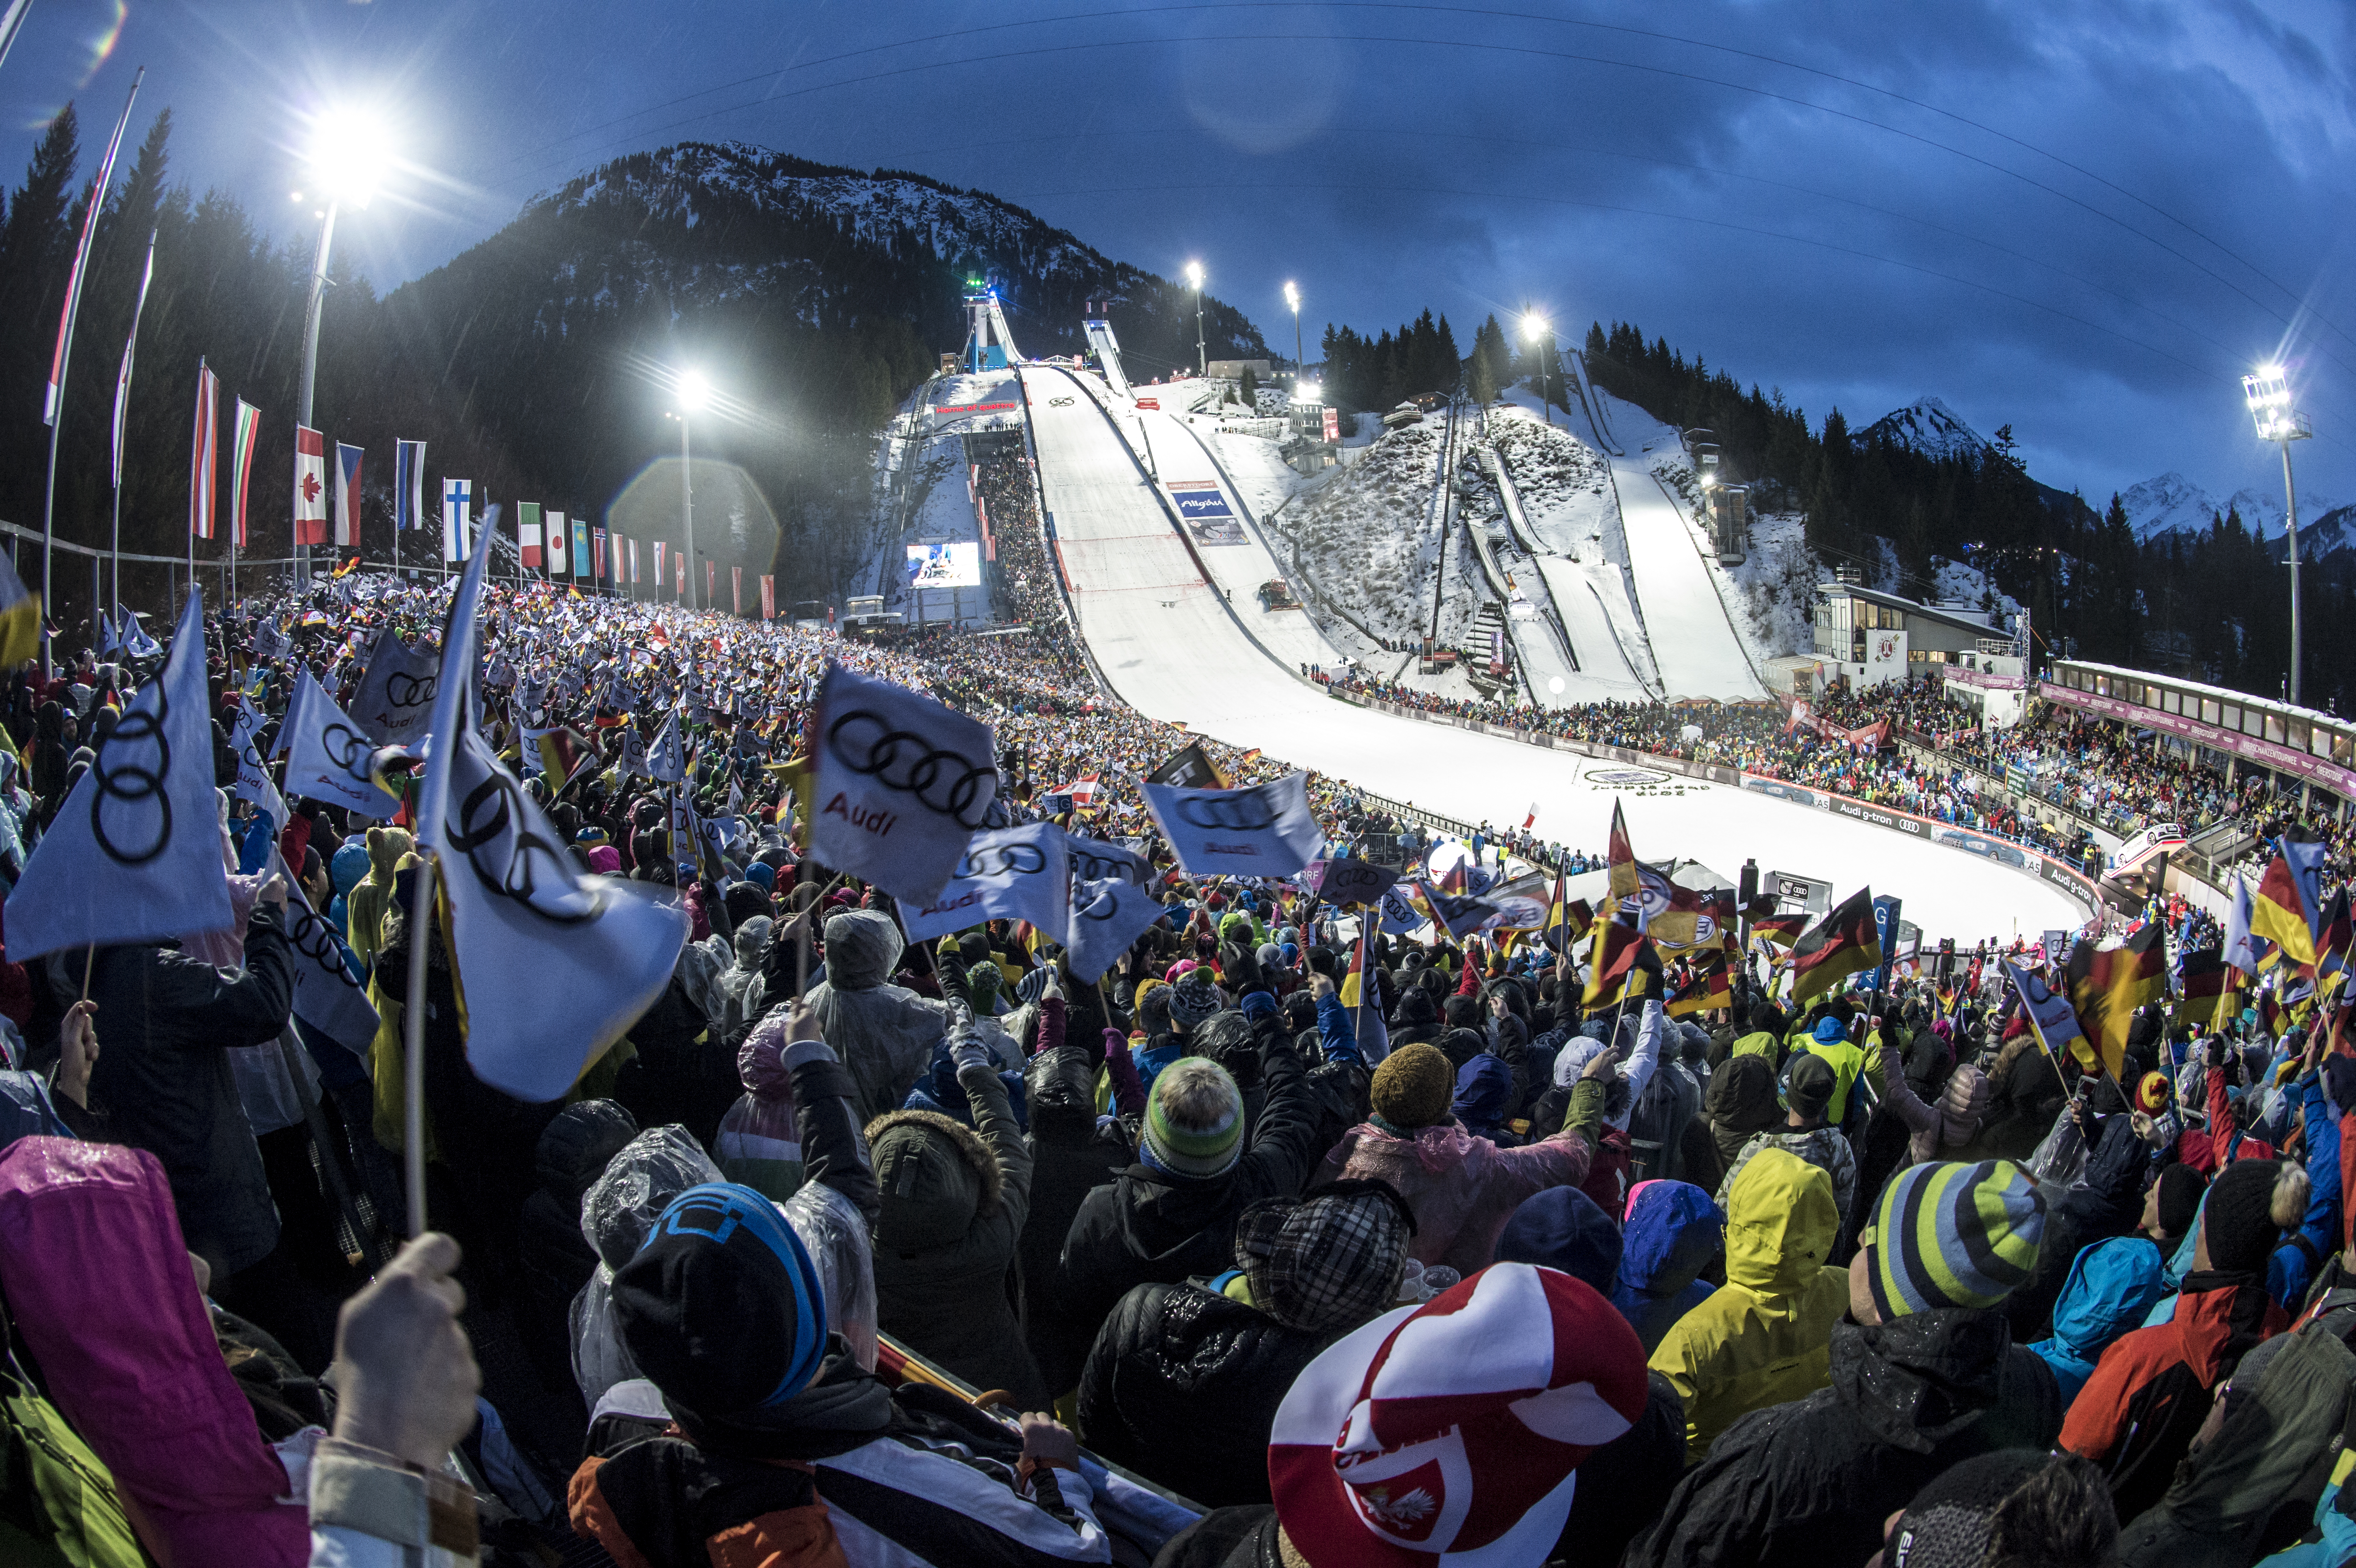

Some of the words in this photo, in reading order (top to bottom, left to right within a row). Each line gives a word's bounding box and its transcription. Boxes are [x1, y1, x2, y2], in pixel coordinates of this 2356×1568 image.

[980, 403, 1015, 411] quattro
[1180, 499, 1224, 510] Allgäu
[374, 712, 416, 729] Audi
[1863, 733, 1877, 743] VIER
[2091, 698, 2112, 710] OBERSTDORF
[2132, 710, 2175, 727] VIERSCHANZENTOURNEE
[2191, 726, 2218, 740] OBERSTDORF
[2243, 740, 2297, 765] VIERSCHANZENTOURNEE
[2316, 765, 2344, 783] OBERSTDORF
[1554, 740, 1588, 751] VIERSCHANZENTOURNEE
[1644, 758, 1684, 771] VIERSCHANZENTOURNEE
[1060, 798, 1071, 809] G
[824, 792, 897, 837] Audi
[1817, 800, 1829, 809] A5
[1840, 803, 1861, 817] Audi
[1863, 812, 1892, 825] g-tron
[2028, 861, 2040, 873] A5
[2051, 869, 2071, 886] Audi
[2071, 881, 2091, 903] g-tron
[1875, 907, 1887, 925] G
[1891, 908, 1899, 925] G
